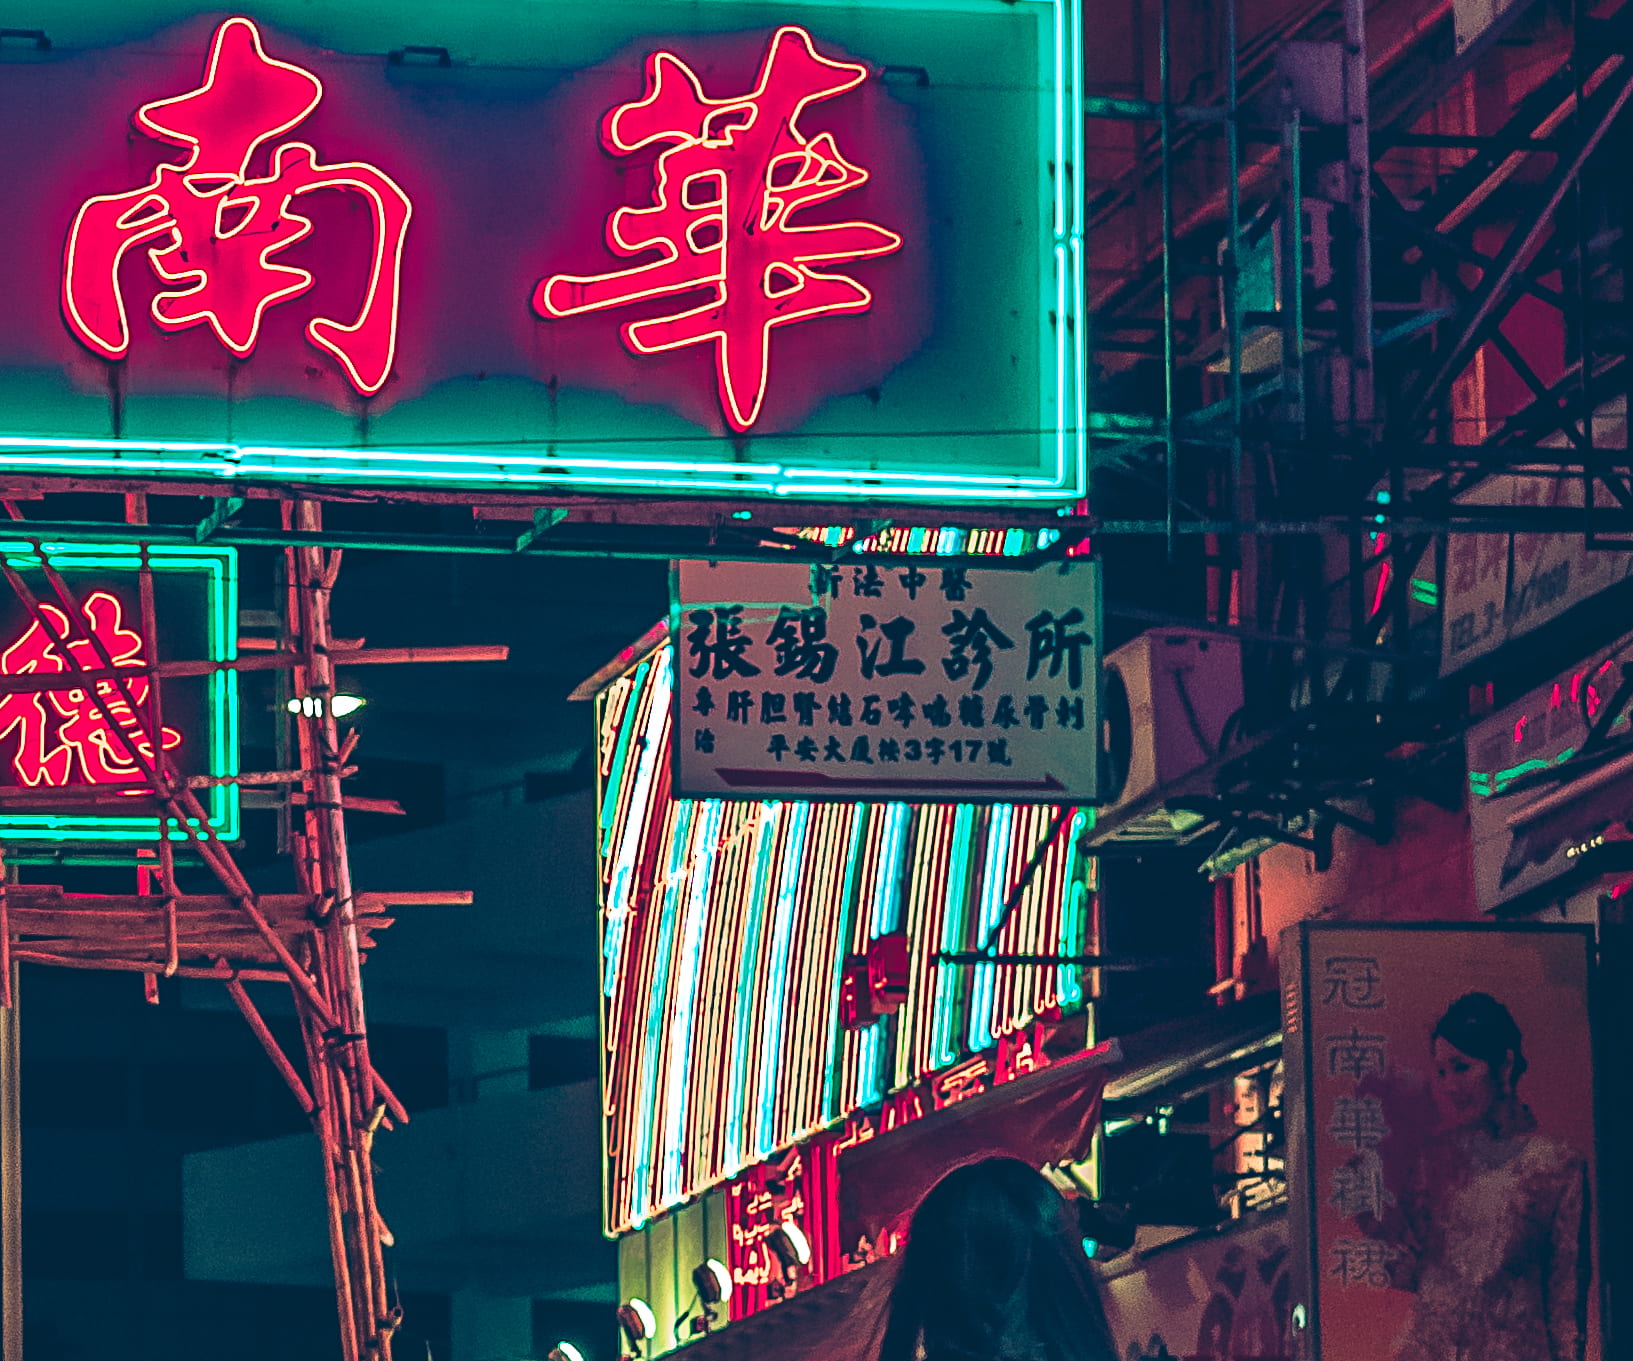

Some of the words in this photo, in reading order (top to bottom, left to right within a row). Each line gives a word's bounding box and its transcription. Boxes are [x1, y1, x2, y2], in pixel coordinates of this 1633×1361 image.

[686, 603, 1094, 692] 張錫江診所
